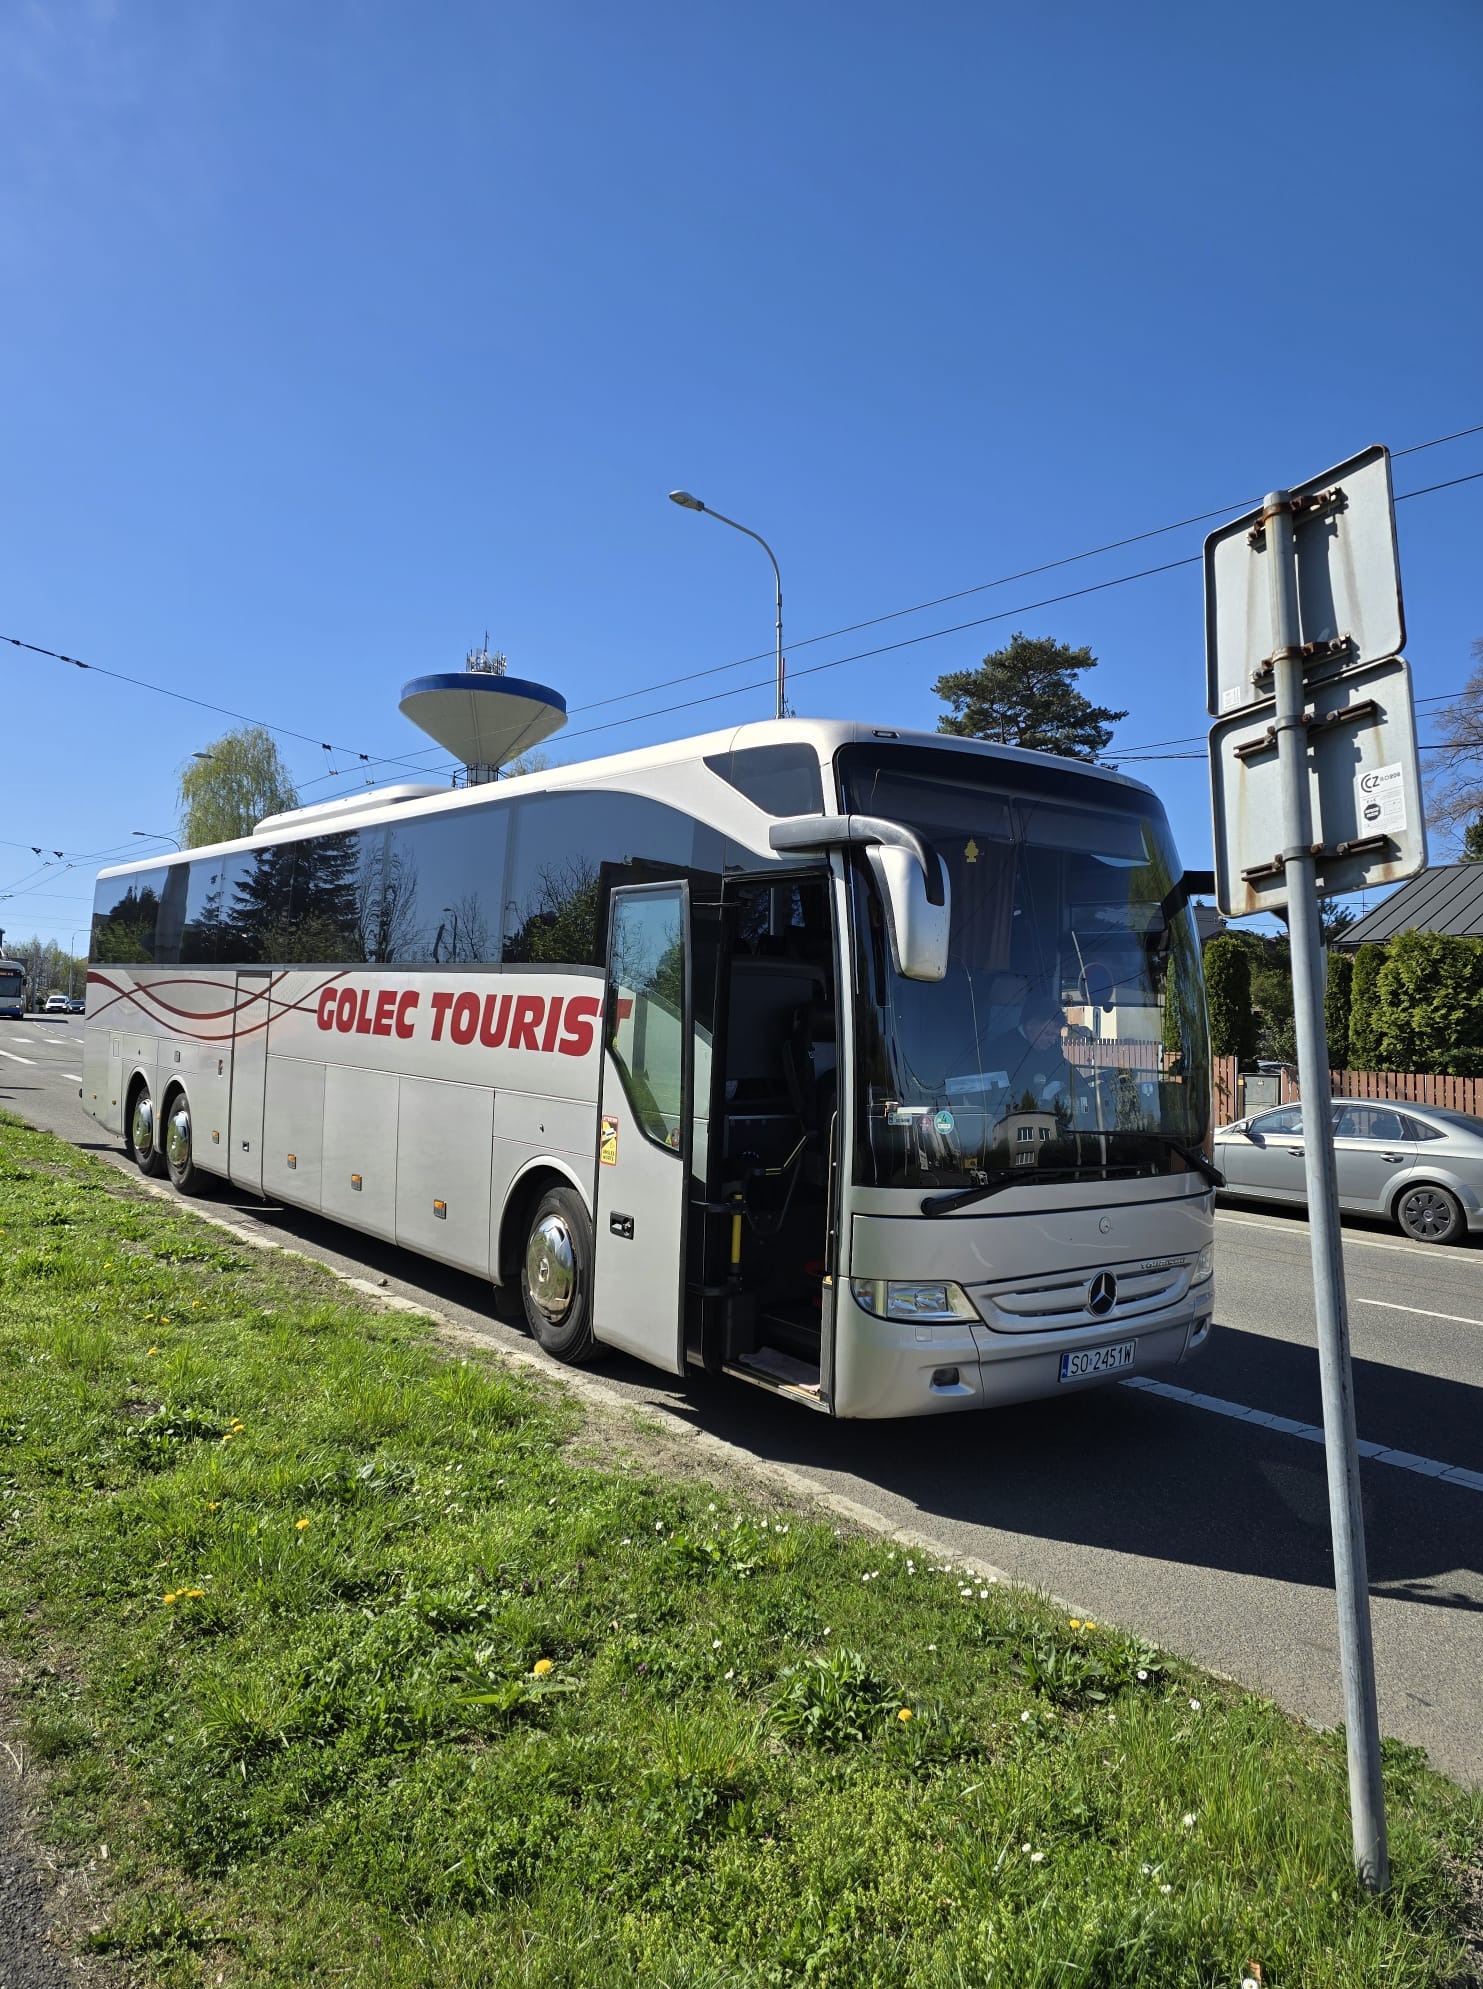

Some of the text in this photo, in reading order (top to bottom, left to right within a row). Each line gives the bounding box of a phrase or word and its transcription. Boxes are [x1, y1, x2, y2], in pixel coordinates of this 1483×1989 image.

[317, 987, 420, 1038] GOLEC
[1071, 1344, 1132, 1374] SO 2451W
